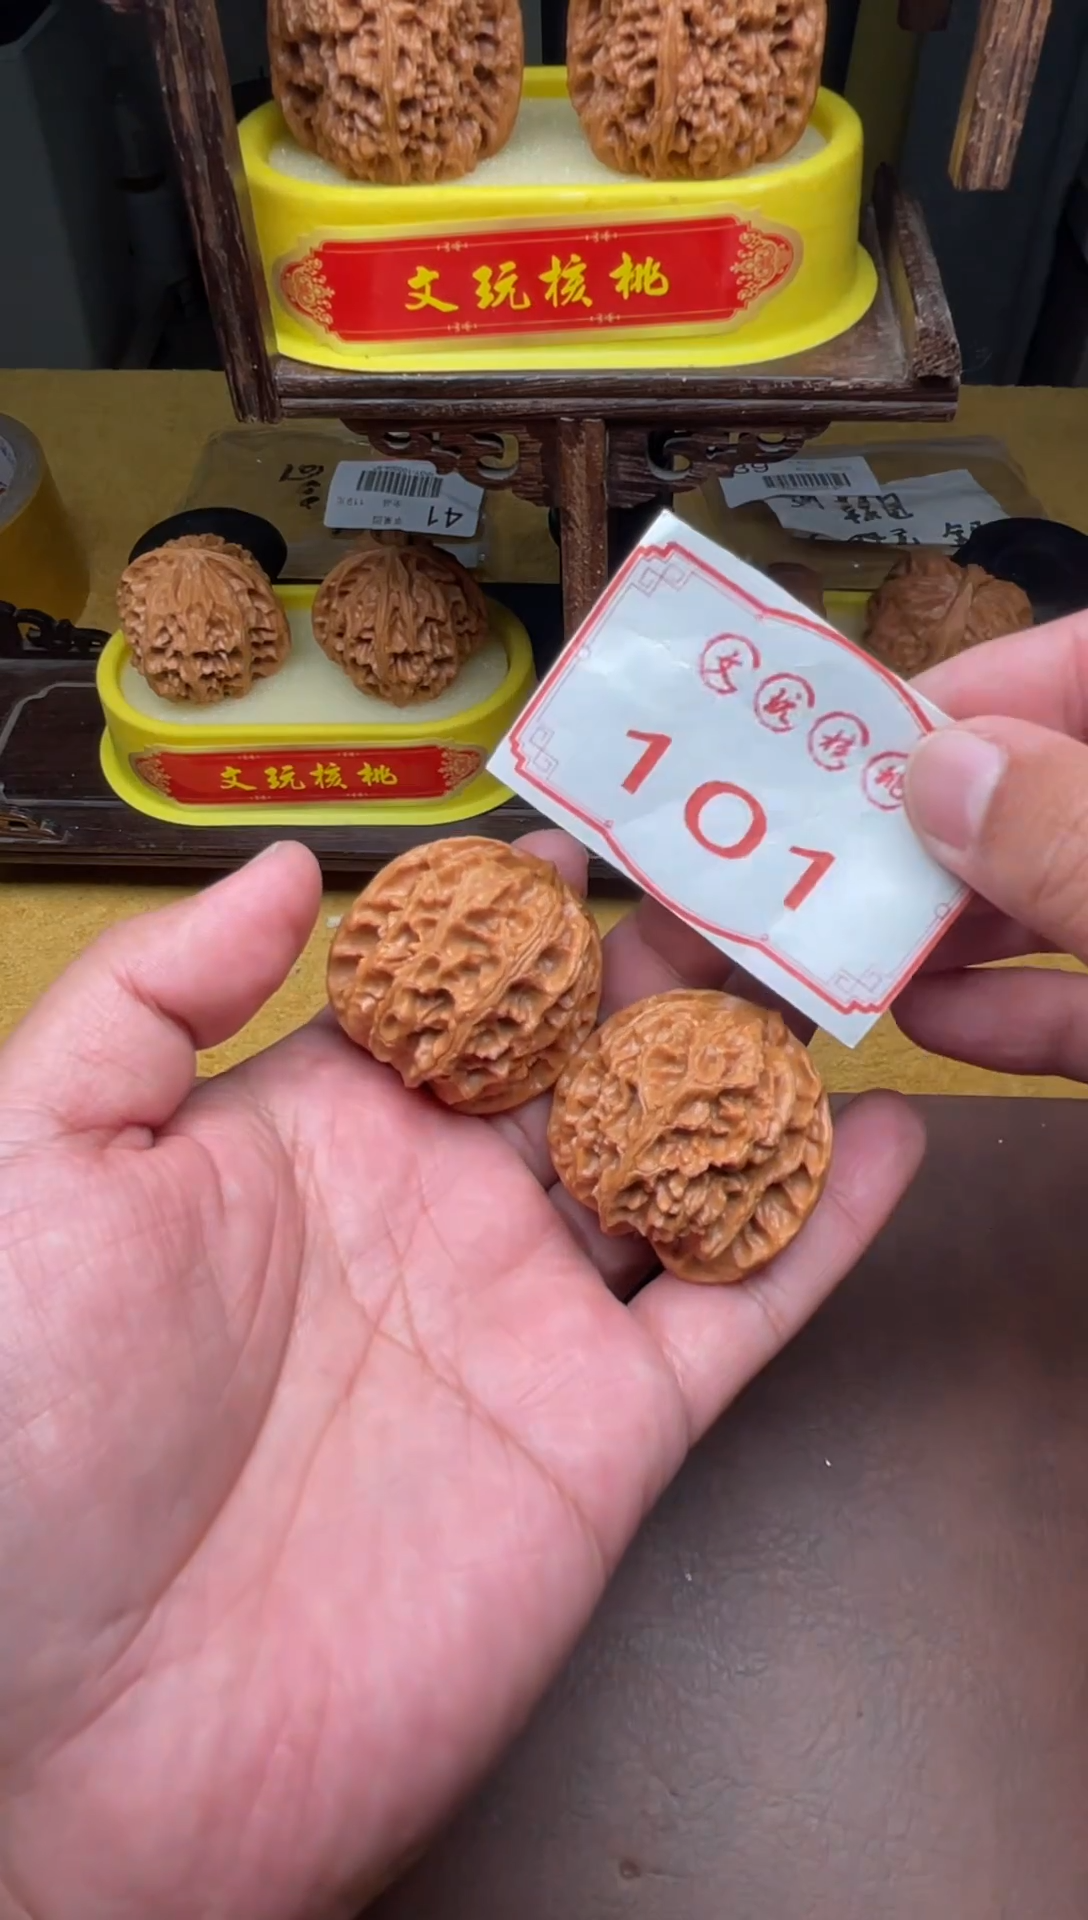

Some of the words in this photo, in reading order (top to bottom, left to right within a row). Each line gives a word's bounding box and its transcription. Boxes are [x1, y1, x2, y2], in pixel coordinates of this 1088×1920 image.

[404, 251, 669, 312] 文玩核桃
[427, 506, 463, 529] 41
[219, 762, 398, 791] 文玩核桃
[621, 729, 837, 911] 101
